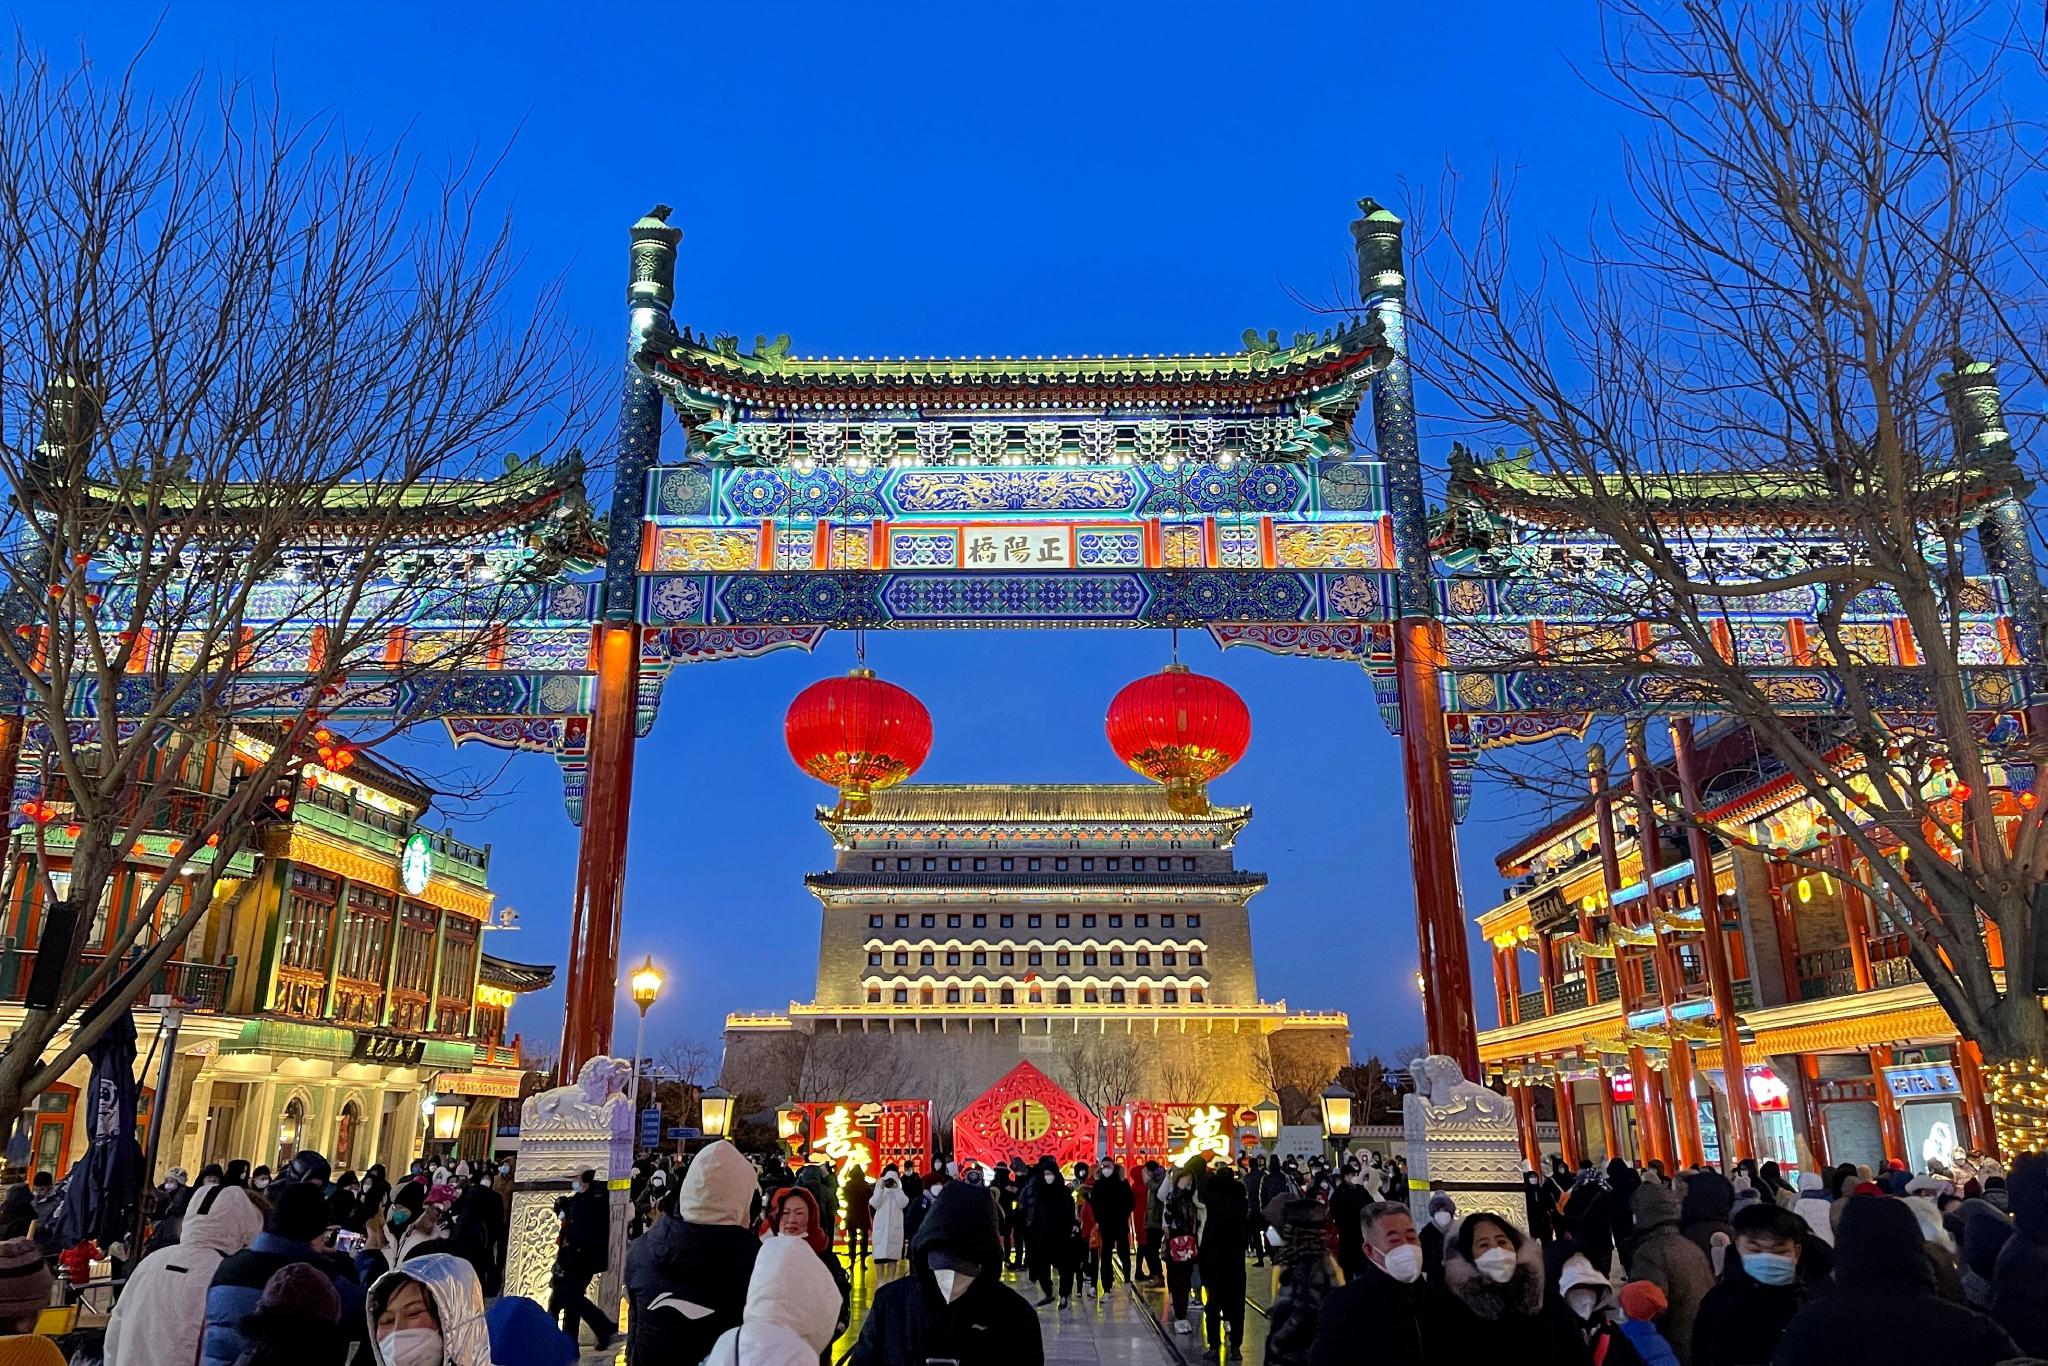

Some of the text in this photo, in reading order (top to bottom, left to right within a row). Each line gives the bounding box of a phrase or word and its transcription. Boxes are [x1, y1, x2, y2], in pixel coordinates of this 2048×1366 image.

[968, 536, 1064, 564] 正陽橋
[1001, 1098, 1051, 1141] 福
